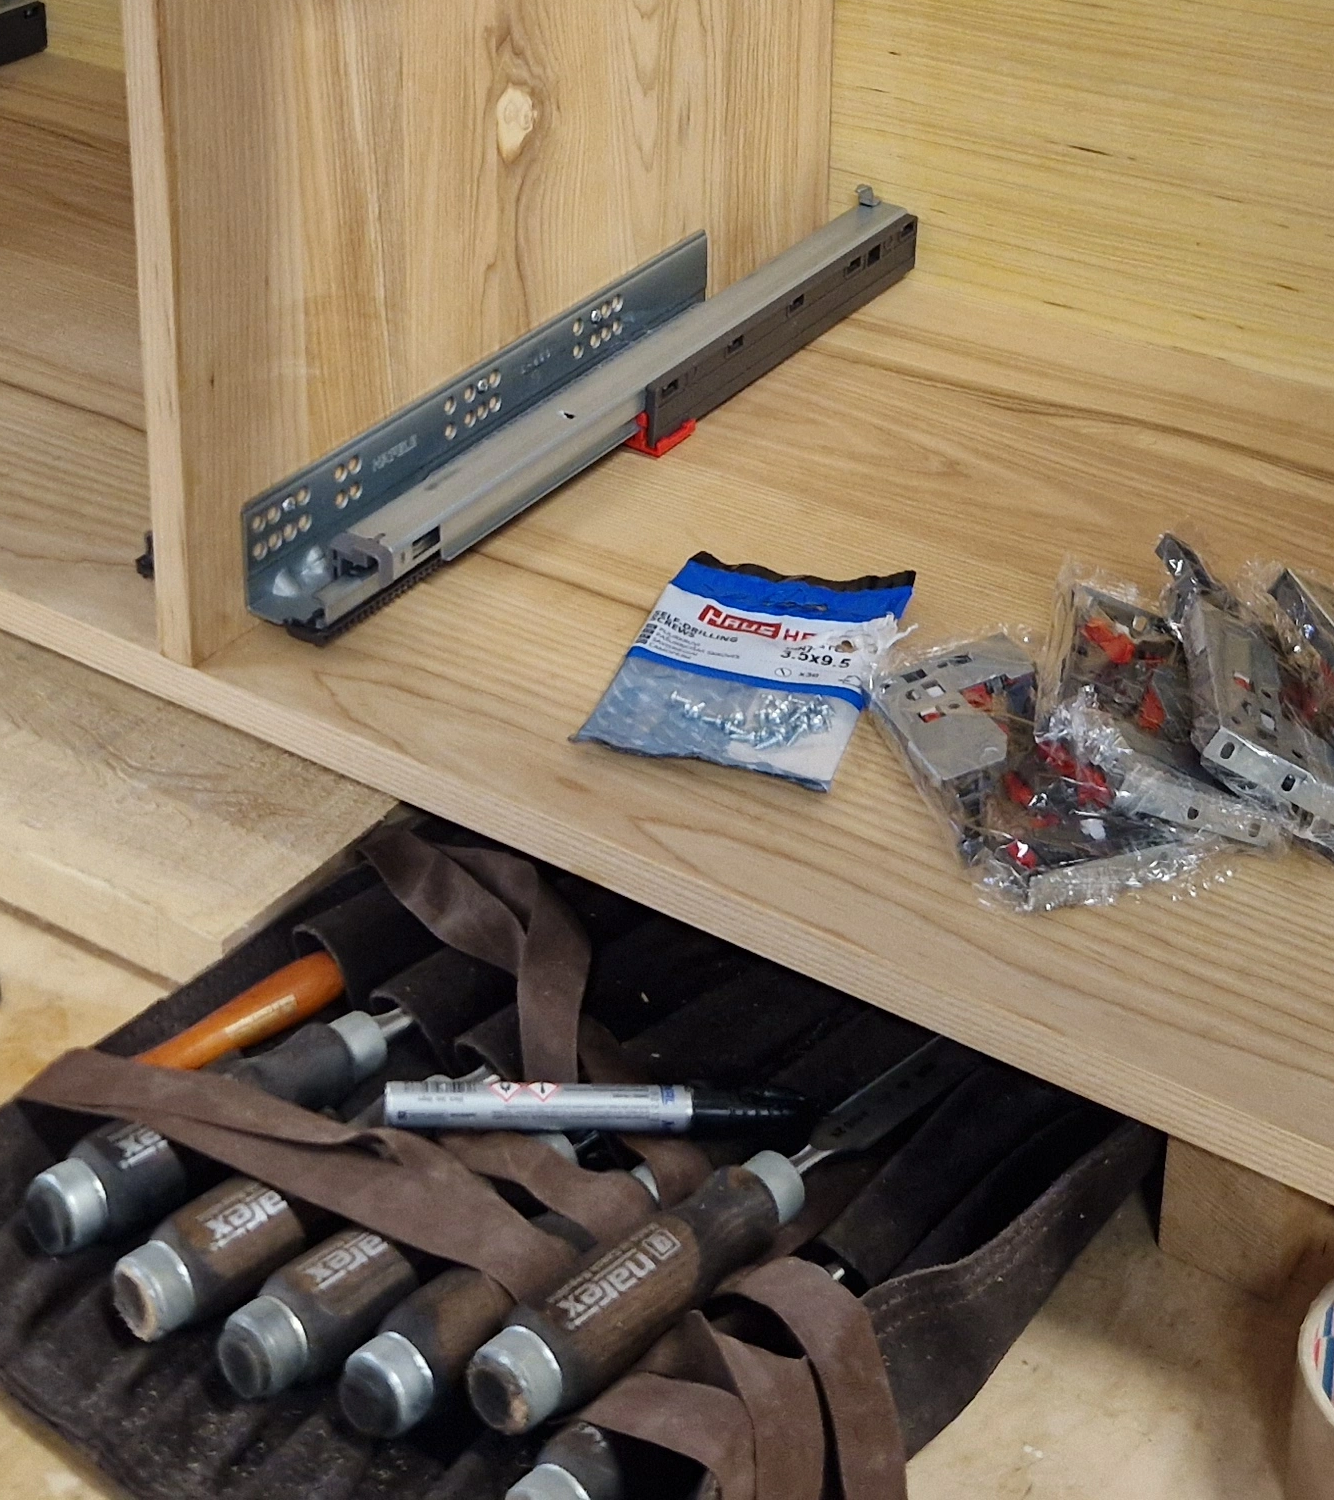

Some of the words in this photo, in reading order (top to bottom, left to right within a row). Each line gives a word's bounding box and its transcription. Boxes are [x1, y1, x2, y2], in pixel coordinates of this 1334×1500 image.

[650, 615, 697, 639] SCREWS
[655, 609, 739, 643] SELF-DRILLING
[780, 648, 852, 669] 3.5x9.5
[204, 1188, 289, 1242] arex
[304, 1232, 389, 1285] arex
[555, 1249, 657, 1320] narex
